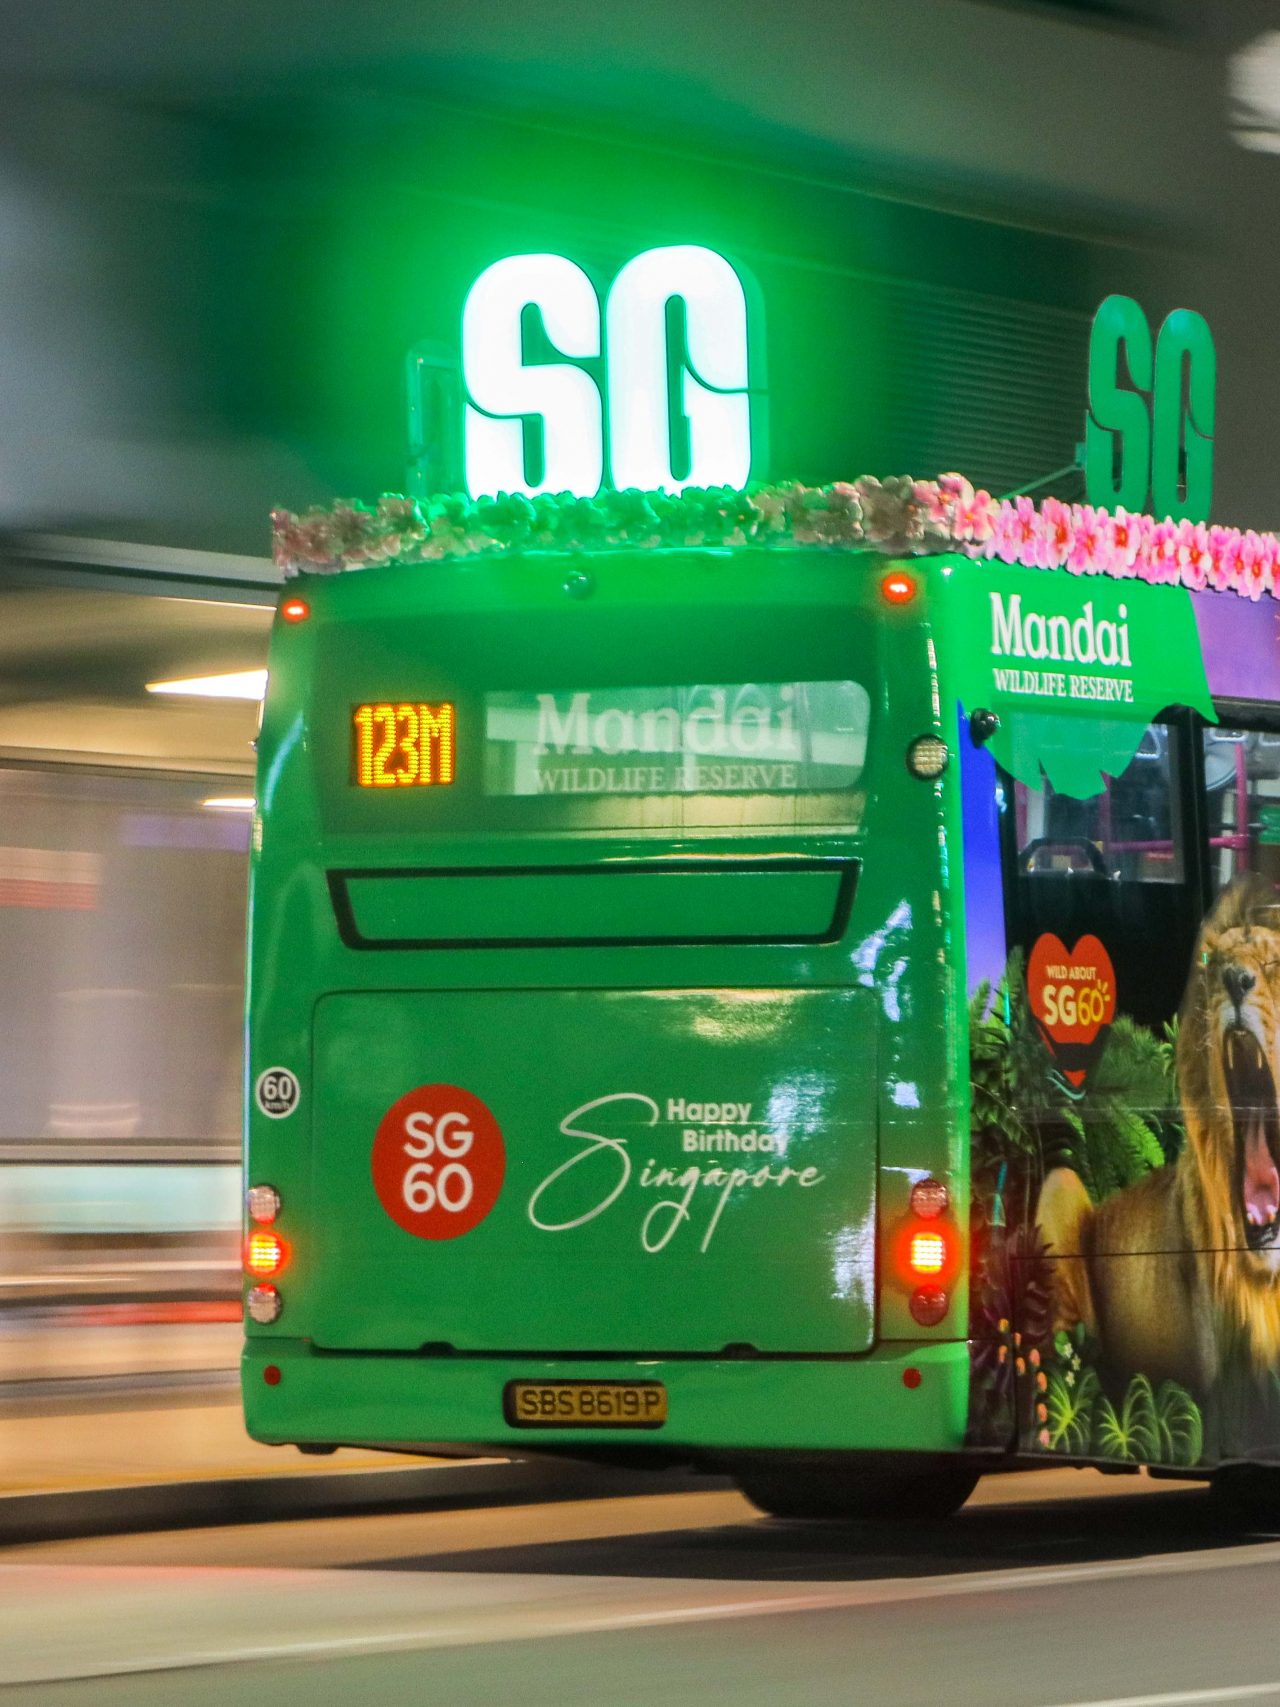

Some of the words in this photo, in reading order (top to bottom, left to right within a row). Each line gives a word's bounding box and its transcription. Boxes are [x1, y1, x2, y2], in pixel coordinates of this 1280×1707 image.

[463, 245, 752, 500] SG
[1086, 294, 1216, 524] SG
[989, 592, 1132, 667] Mandai
[992, 668, 1066, 697] WILDLIFE
[1069, 674, 1134, 702] RESERVE
[535, 683, 799, 756] Mandai
[355, 703, 455, 787] 123M
[535, 766, 664, 793] WILDLIFE
[674, 764, 796, 791] RESERVE
[1046, 965, 1068, 980] WILD
[1069, 966, 1097, 980] ABOUT
[1042, 984, 1105, 1026] SG60
[263, 1076, 292, 1100] 60
[667, 1098, 752, 1125] Happy
[403, 1111, 474, 1159] SG
[682, 1129, 790, 1156] Birthday
[402, 1162, 473, 1213] 60
[528, 1092, 826, 1253] Singapore
